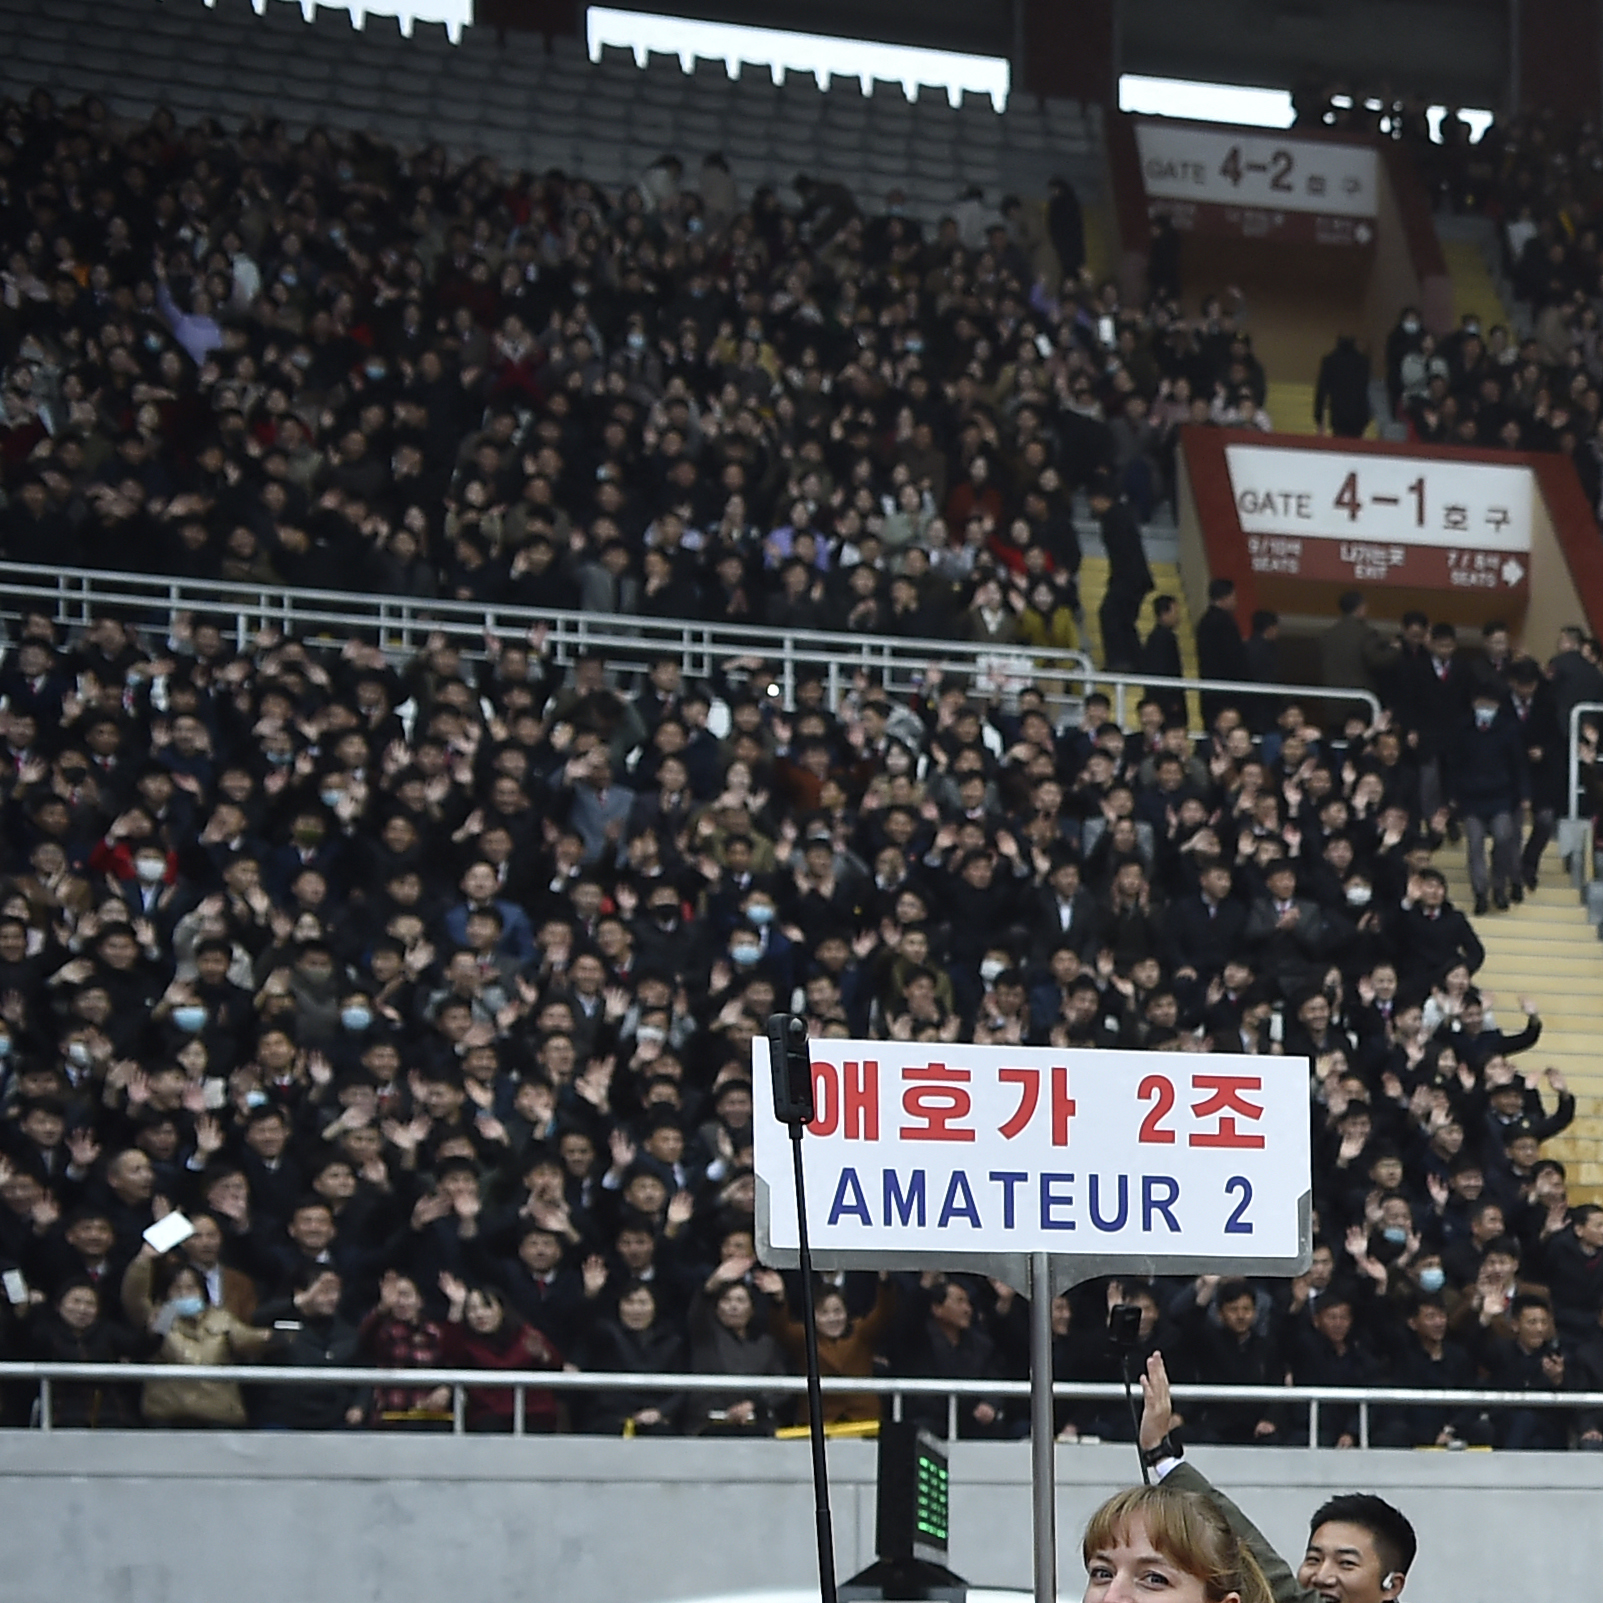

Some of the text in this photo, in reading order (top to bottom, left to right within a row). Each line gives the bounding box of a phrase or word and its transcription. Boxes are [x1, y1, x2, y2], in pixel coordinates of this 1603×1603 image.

[1219, 144, 1293, 192] 4-2
[1238, 471, 1426, 527] GATE 4-1
[808, 1060, 1266, 1149] 애호가 2조
[827, 1167, 1254, 1234] AMATEUR 2
